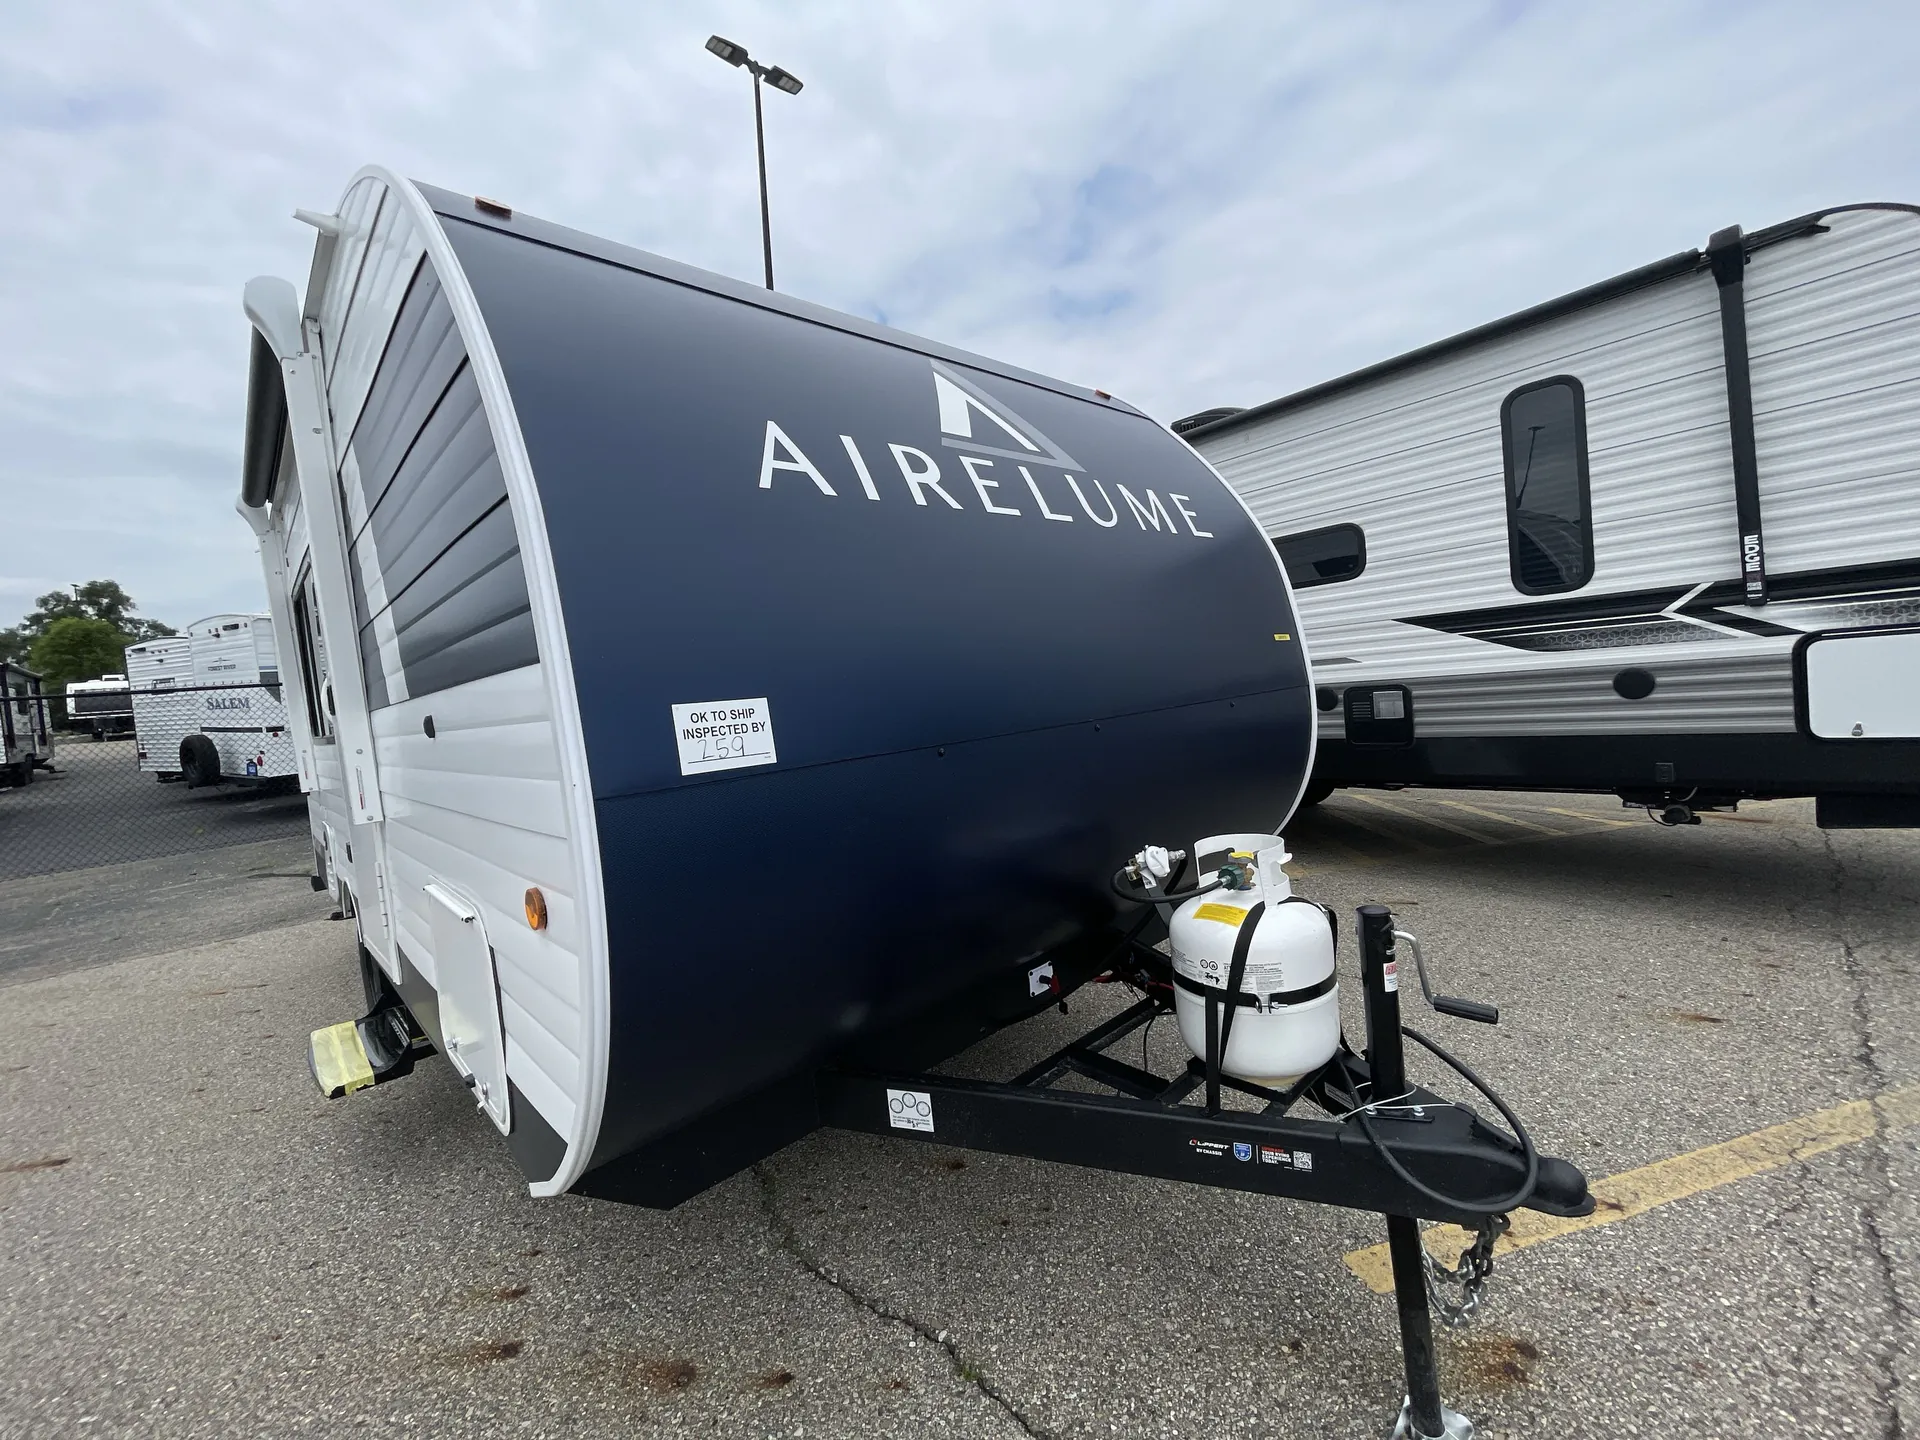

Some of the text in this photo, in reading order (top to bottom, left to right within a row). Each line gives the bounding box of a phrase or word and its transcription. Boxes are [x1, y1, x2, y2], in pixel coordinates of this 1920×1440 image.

[759, 420, 1214, 539] AIRELUME
[1744, 534, 1761, 572] EDGE
[206, 697, 250, 710] SALEM
[690, 708, 755, 723] OK TO SHIP
[683, 721, 766, 740] INSPECTED BY
[697, 735, 746, 759] 259
